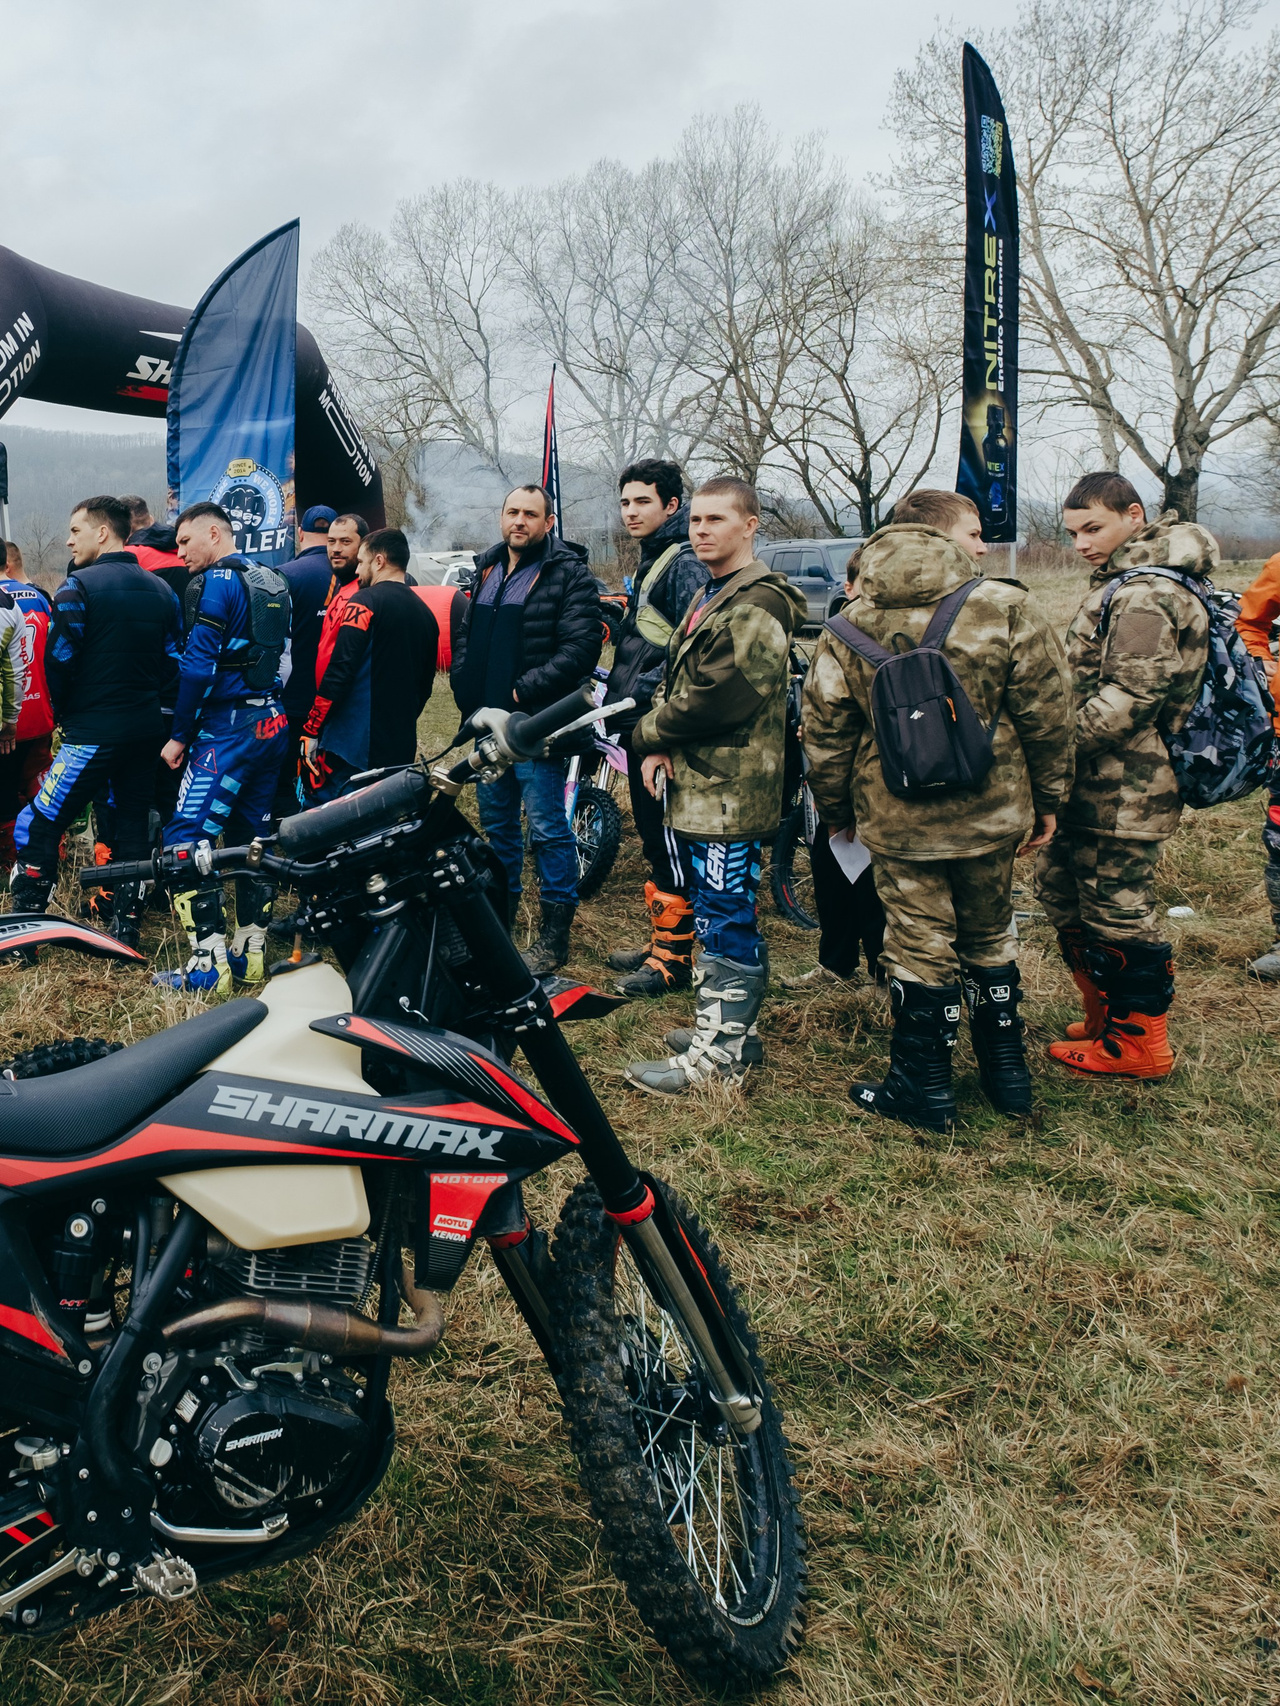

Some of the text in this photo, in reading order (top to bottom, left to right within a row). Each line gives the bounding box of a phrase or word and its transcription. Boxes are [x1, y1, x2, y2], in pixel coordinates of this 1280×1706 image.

[13, 311, 35, 342] IN
[318, 389, 372, 487] MOTION
[1068, 1050, 1085, 1064] X6
[860, 1088, 875, 1102] X6
[207, 1085, 506, 1161] SHARMAX
[432, 1174, 509, 1185] MOTORS
[437, 1216, 468, 1229] MOTUL
[431, 1229, 467, 1243] KENDA
[224, 1427, 284, 1452] SHARMAX
